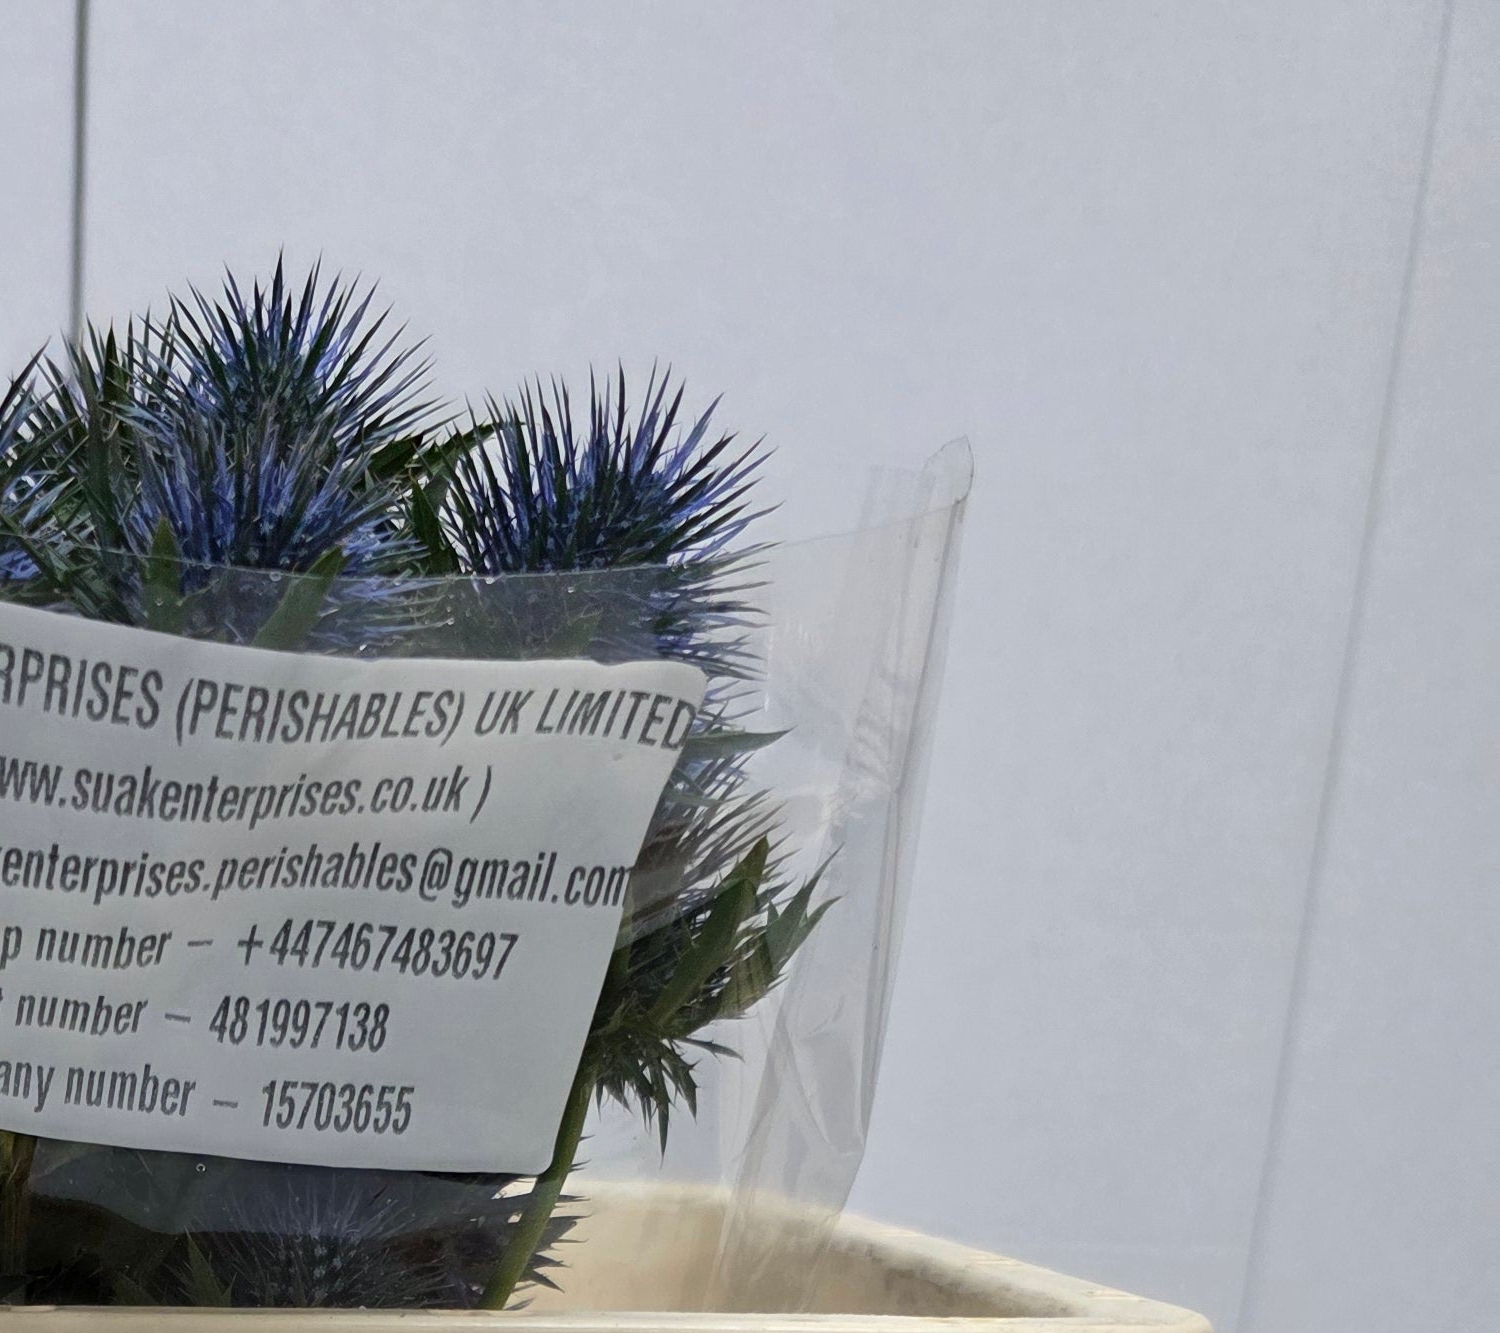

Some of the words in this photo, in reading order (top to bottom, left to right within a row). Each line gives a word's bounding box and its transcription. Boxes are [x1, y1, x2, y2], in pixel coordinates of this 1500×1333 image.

[176, 678, 464, 746] (PERISHABLES)
[475, 690, 534, 735] UK
[535, 689, 696, 750] LIMITED
[36, 923, 172, 969] number
[238, 920, 519, 980] +447467483697
[15, 991, 148, 1035] number
[209, 996, 389, 1052] 481997138
[65, 1065, 196, 1116] number
[263, 1080, 414, 1134] 15703655
